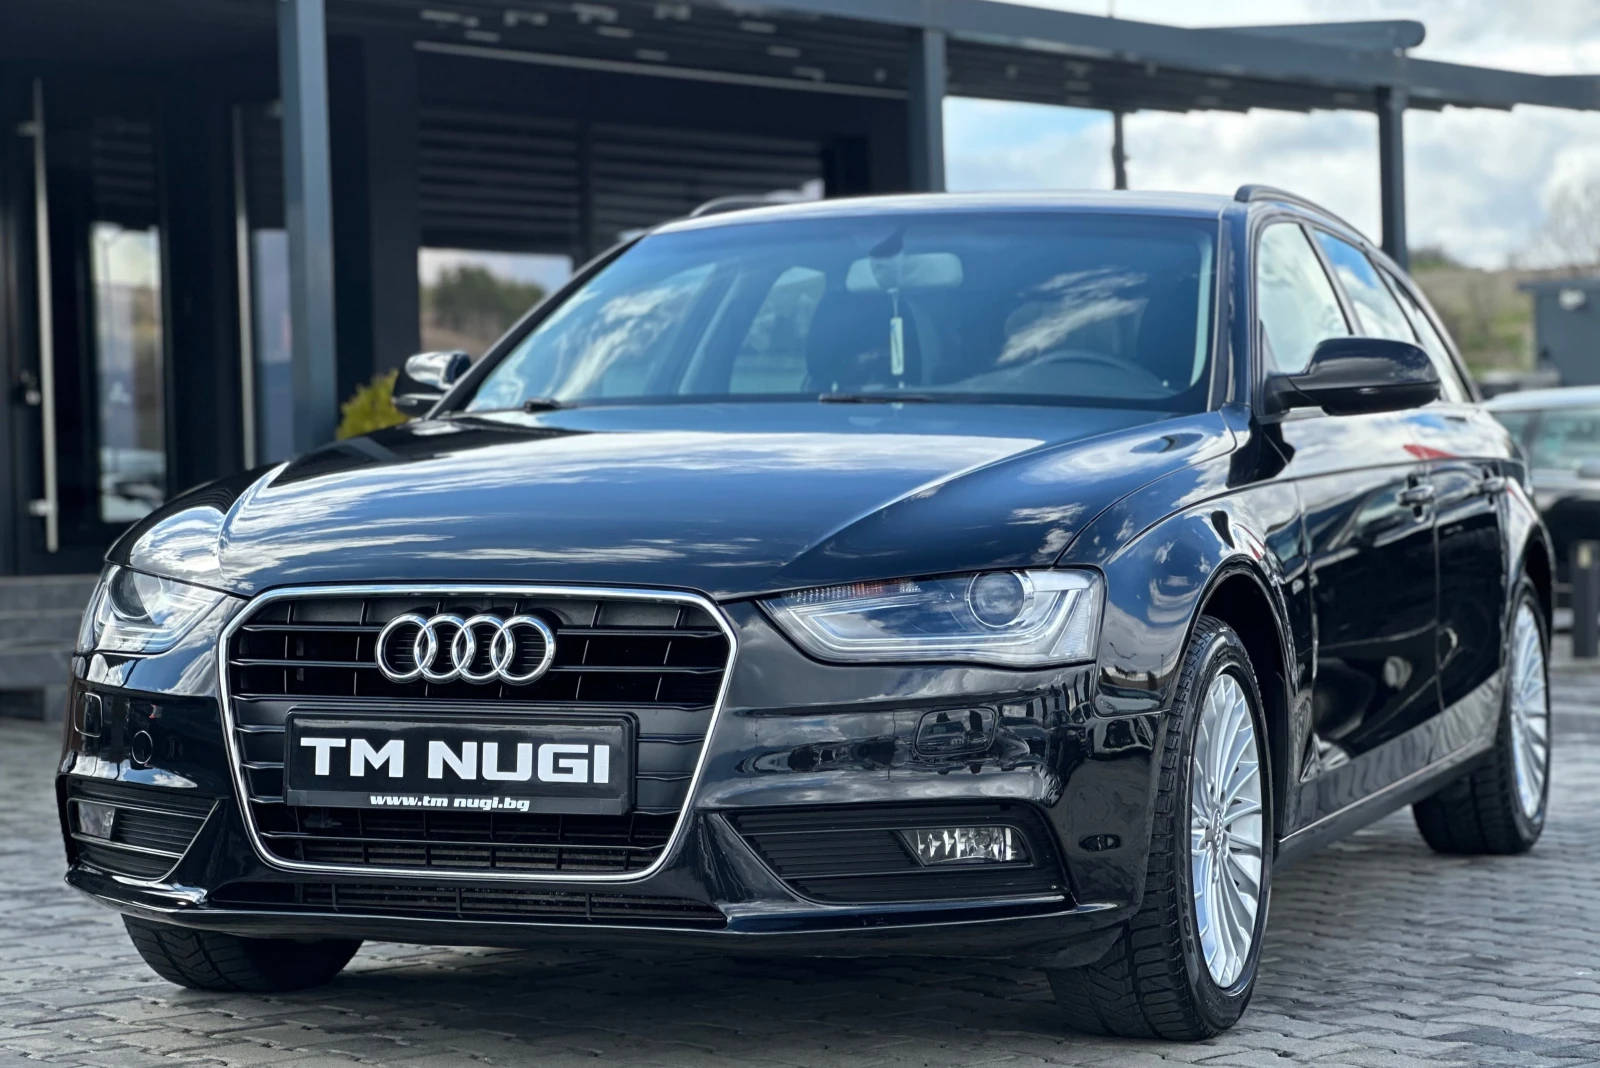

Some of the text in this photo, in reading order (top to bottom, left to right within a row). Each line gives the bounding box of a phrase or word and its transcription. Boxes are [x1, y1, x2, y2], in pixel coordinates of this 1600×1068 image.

[300, 737, 610, 784] TM NUGI
[369, 795, 531, 812] www.tm nugi.bg
